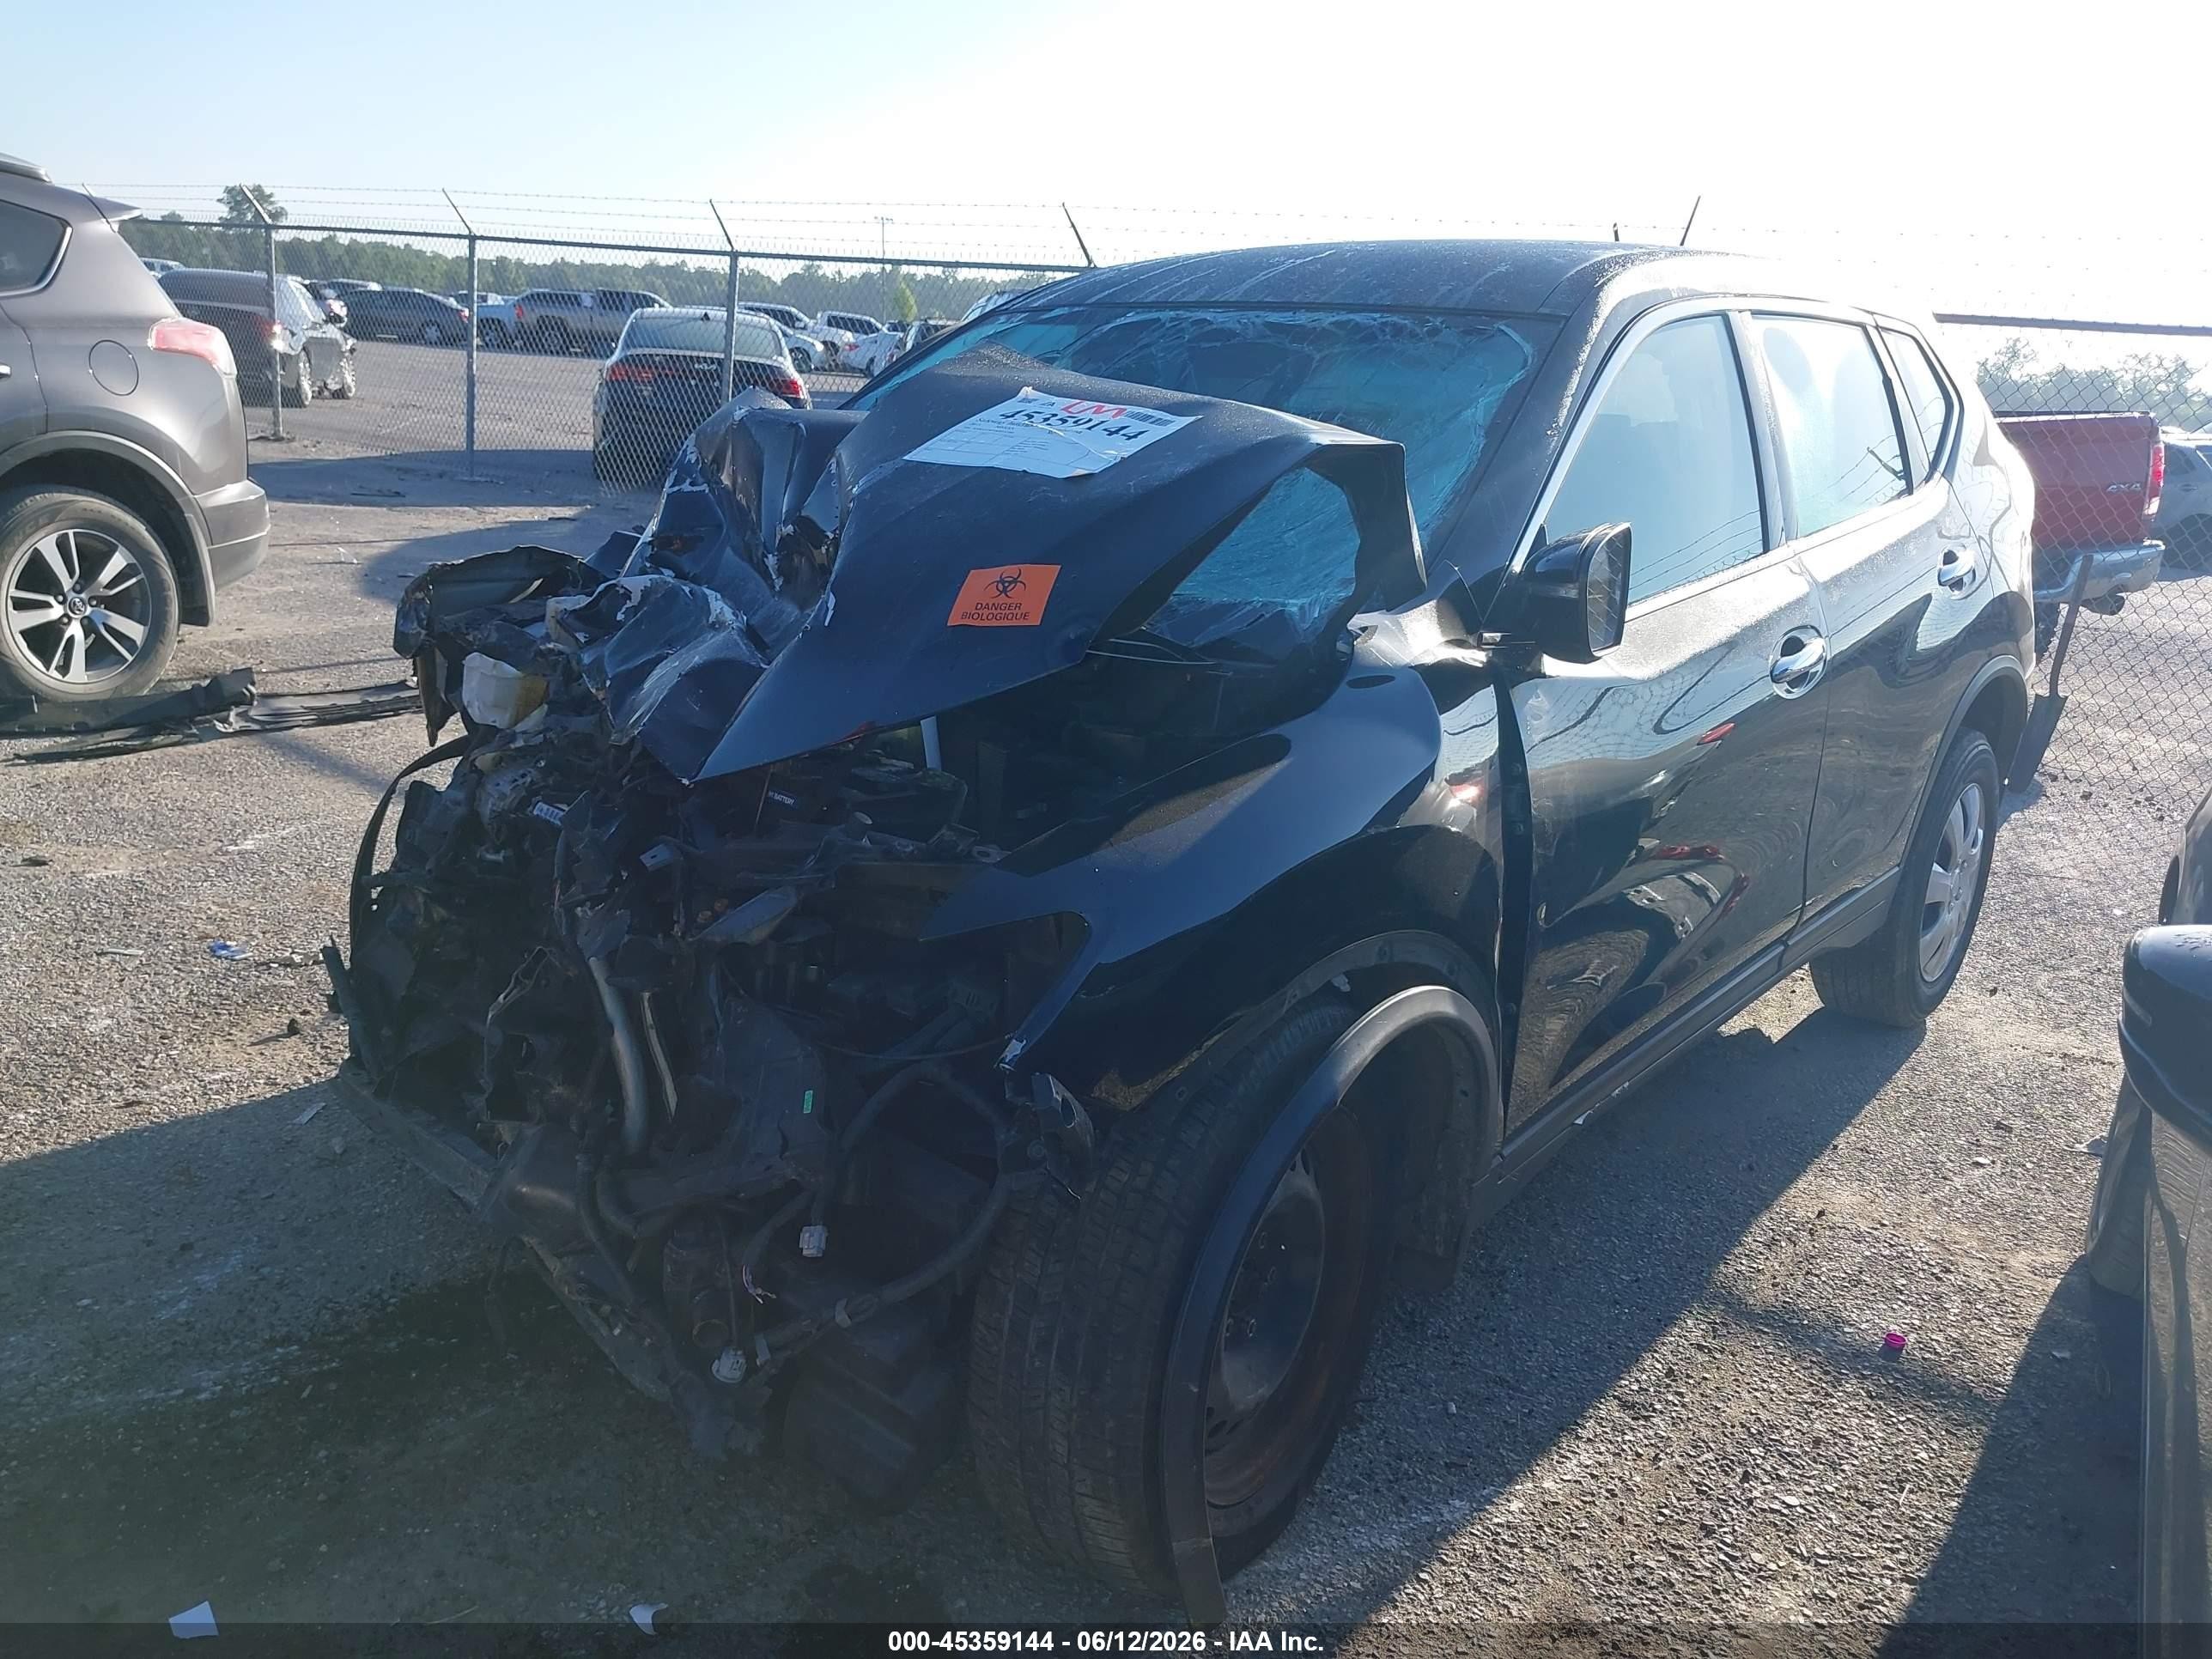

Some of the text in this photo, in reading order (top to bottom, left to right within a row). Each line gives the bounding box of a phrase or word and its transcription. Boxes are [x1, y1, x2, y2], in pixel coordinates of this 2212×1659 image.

[999, 409, 1149, 441] 45359144
[975, 602, 1023, 611] DANGER
[961, 611, 1030, 621] BIOLOGIQUE
